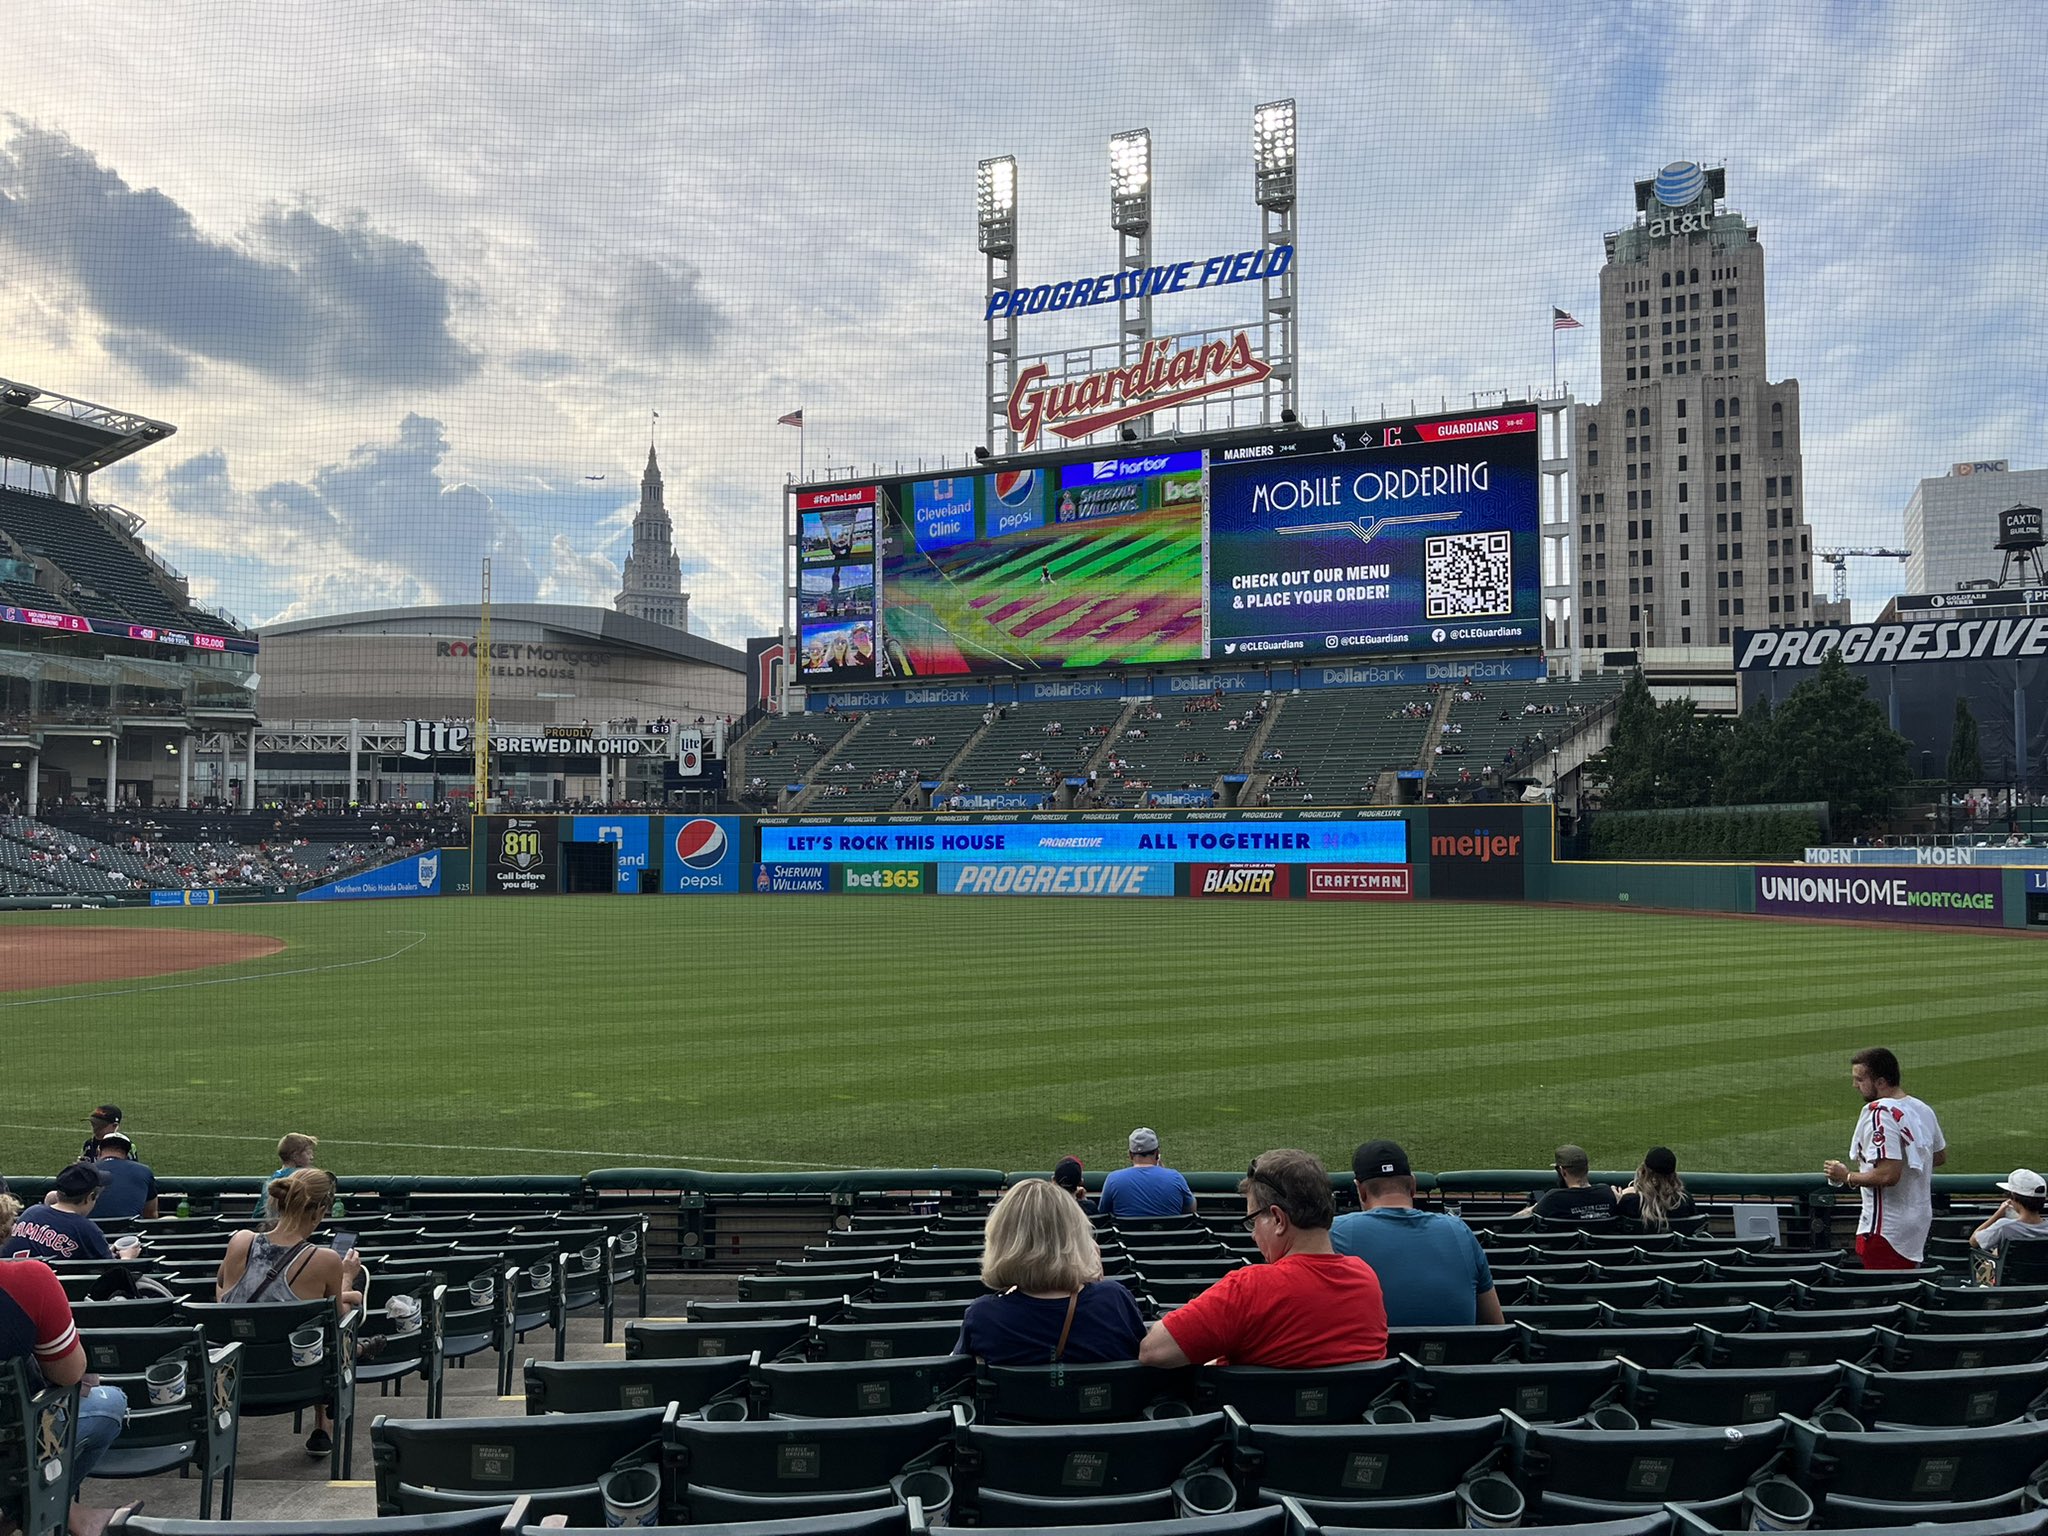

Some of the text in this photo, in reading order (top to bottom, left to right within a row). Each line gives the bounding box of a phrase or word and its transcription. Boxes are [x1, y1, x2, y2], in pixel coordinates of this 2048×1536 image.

[1648, 206, 1711, 238] at&t
[983, 245, 1294, 321] PROGRESSIVE FIELD
[1006, 330, 1273, 451] Guardians
[1438, 420, 1499, 437] GUARDIANS
[1224, 445, 1274, 461] MARINERS
[1119, 456, 1171, 476] harbor
[1974, 461, 2005, 474] PNC
[1252, 461, 1489, 513] MOBILE ORDERING
[813, 490, 862, 504] #ForTheLand
[916, 499, 971, 523] Cleveland
[999, 509, 1033, 530] pepsi
[929, 520, 961, 537] Clinic
[1232, 564, 1391, 590] CHECK OUT OUR MENU
[1232, 584, 1391, 610] & PLACE YOUR ORDER!
[1340, 633, 1409, 647] @CLEGuardians
[1449, 627, 1522, 641] @CLEGuardians
[1239, 640, 1304, 653] @CLEGuardians
[1739, 617, 2048, 669] PROGRESSIVE
[527, 644, 612, 667] Mortgage
[1323, 666, 1405, 684] DollarBank
[1425, 660, 1512, 680] DollarBank
[1034, 681, 1103, 698] DollarBank
[1170, 674, 1246, 691] DollarBank
[828, 691, 890, 707] DollarBank
[904, 688, 969, 704] DollarBank
[544, 727, 593, 738] PROUDLY
[652, 725, 669, 734] 6:13
[401, 719, 470, 760] Lite
[496, 738, 640, 754] BREWED IN OHIO
[681, 738, 700, 752] Lite
[957, 795, 1028, 810] DollarBank
[1241, 811, 1283, 819] PROGRESSIVE
[504, 831, 537, 856] 811
[787, 835, 1005, 851] LET'S ROCK THIS HOUSE
[1038, 837, 1103, 848] PROGRESSIVE
[1138, 833, 1178, 849] ALL
[1187, 833, 1311, 849] TOGETHER
[1431, 829, 1520, 862] meijer
[1804, 848, 1852, 864] MOEN
[1916, 847, 1972, 865] MOEN
[497, 872, 546, 880] Call before
[773, 865, 822, 878] SHERWIN
[846, 869, 919, 888] bet365
[954, 865, 1149, 894] PROGRESSIVE
[334, 882, 418, 893] Northern Ohio Honda Dealers
[456, 883, 470, 891] 325
[502, 880, 539, 889] you dig.
[680, 874, 723, 889] pepsi
[1203, 869, 1275, 893] BLASTER
[1316, 875, 1401, 888] CRAFTSMAN
[1907, 891, 1994, 910] MORTGAGE
